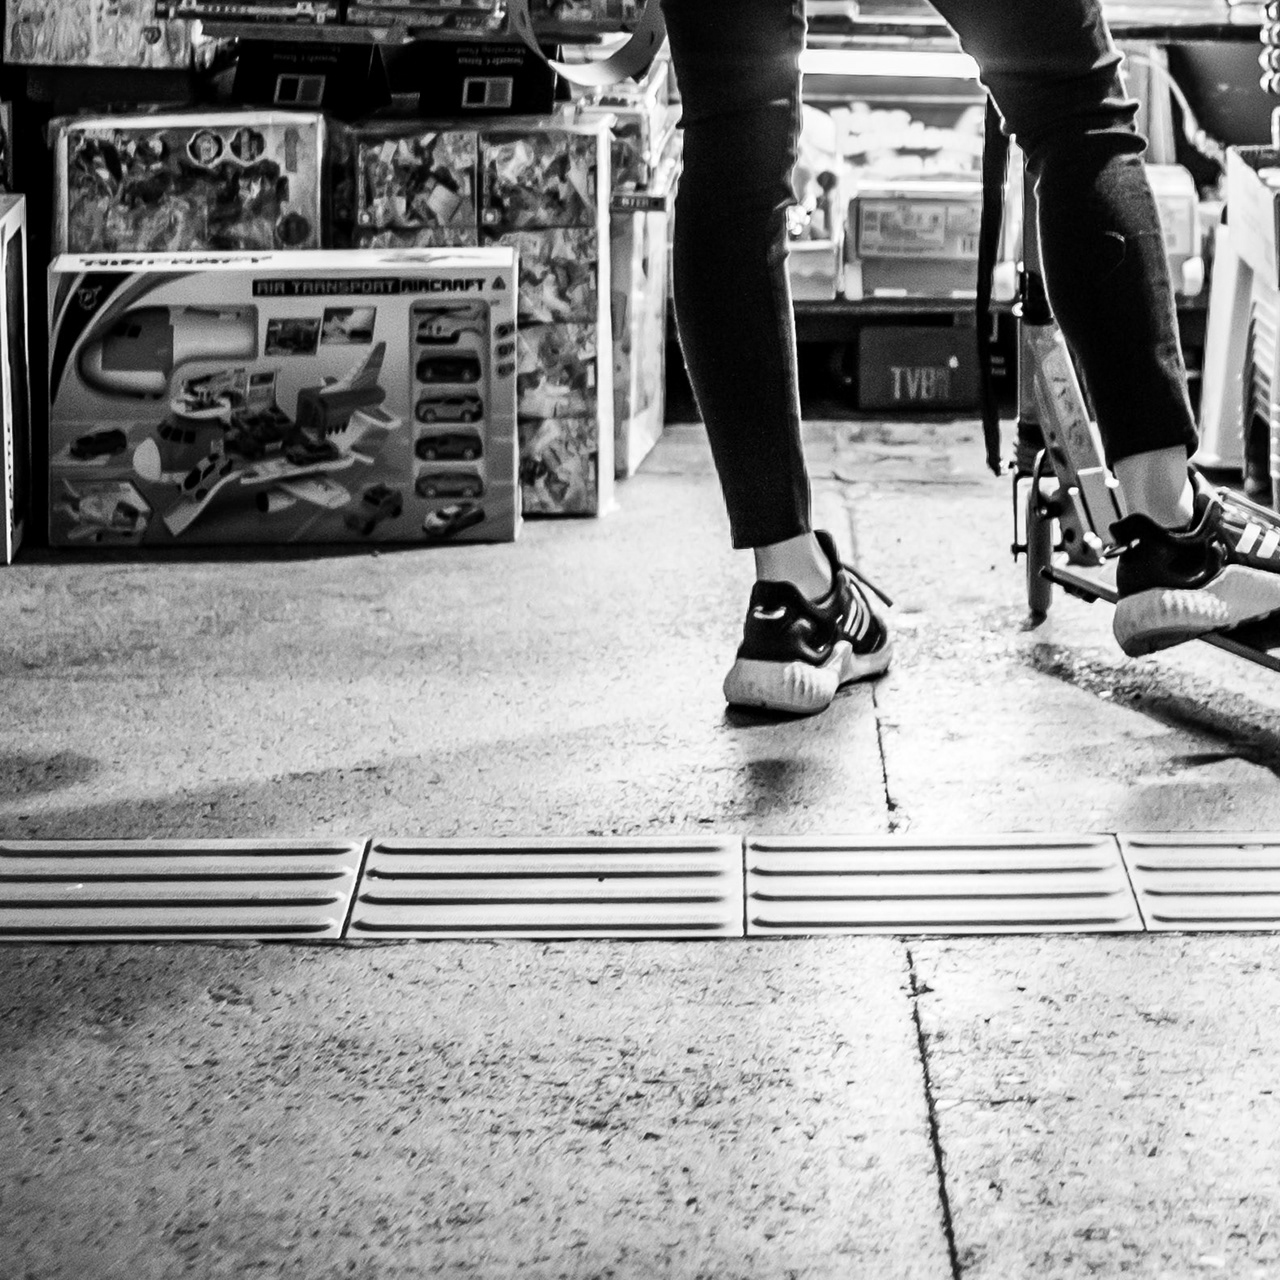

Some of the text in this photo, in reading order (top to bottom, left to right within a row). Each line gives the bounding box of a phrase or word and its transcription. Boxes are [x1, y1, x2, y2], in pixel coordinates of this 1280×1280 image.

[256, 277, 486, 295] AIR TRANSPORT AIRCRAFT
